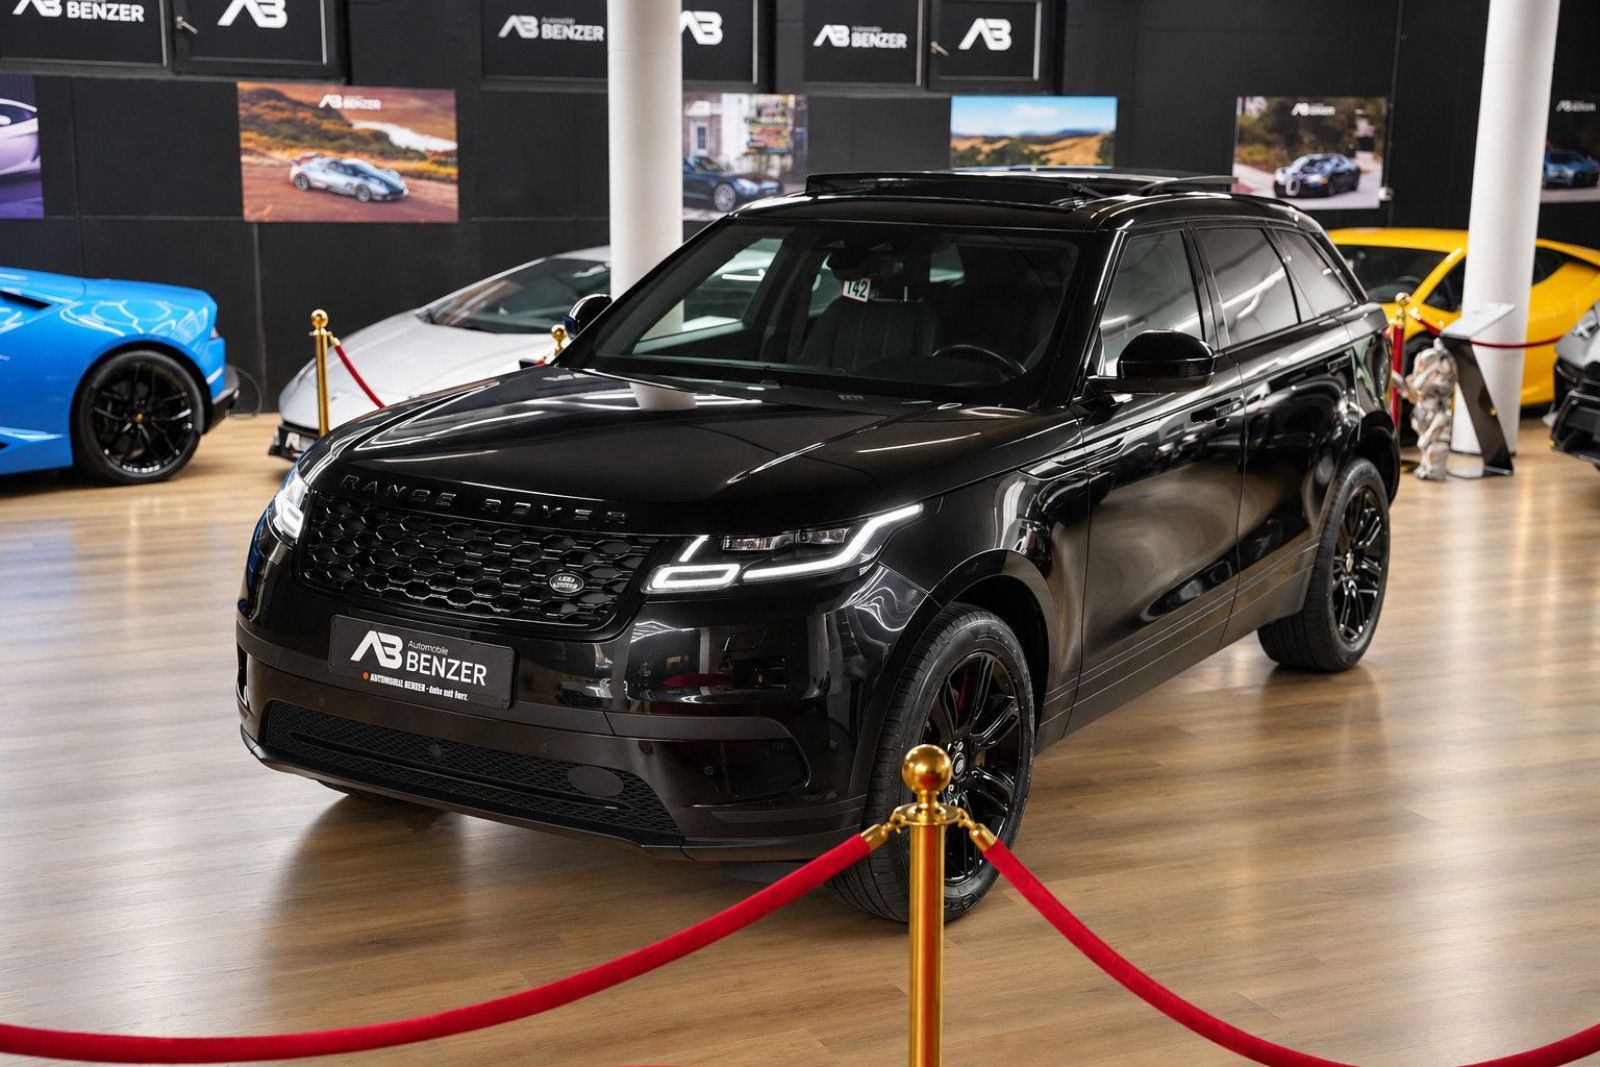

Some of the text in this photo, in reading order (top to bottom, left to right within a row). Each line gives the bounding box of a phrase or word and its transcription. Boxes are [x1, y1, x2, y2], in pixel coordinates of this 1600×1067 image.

[66, 1, 145, 22] BENZER
[541, 23, 605, 41] BENZER
[851, 32, 907, 48] BENZER
[846, 280, 868, 299] 142
[340, 474, 456, 506] RANGE
[480, 498, 626, 523] ROVER
[407, 640, 449, 655] Automobile
[405, 651, 488, 686] BENZER
